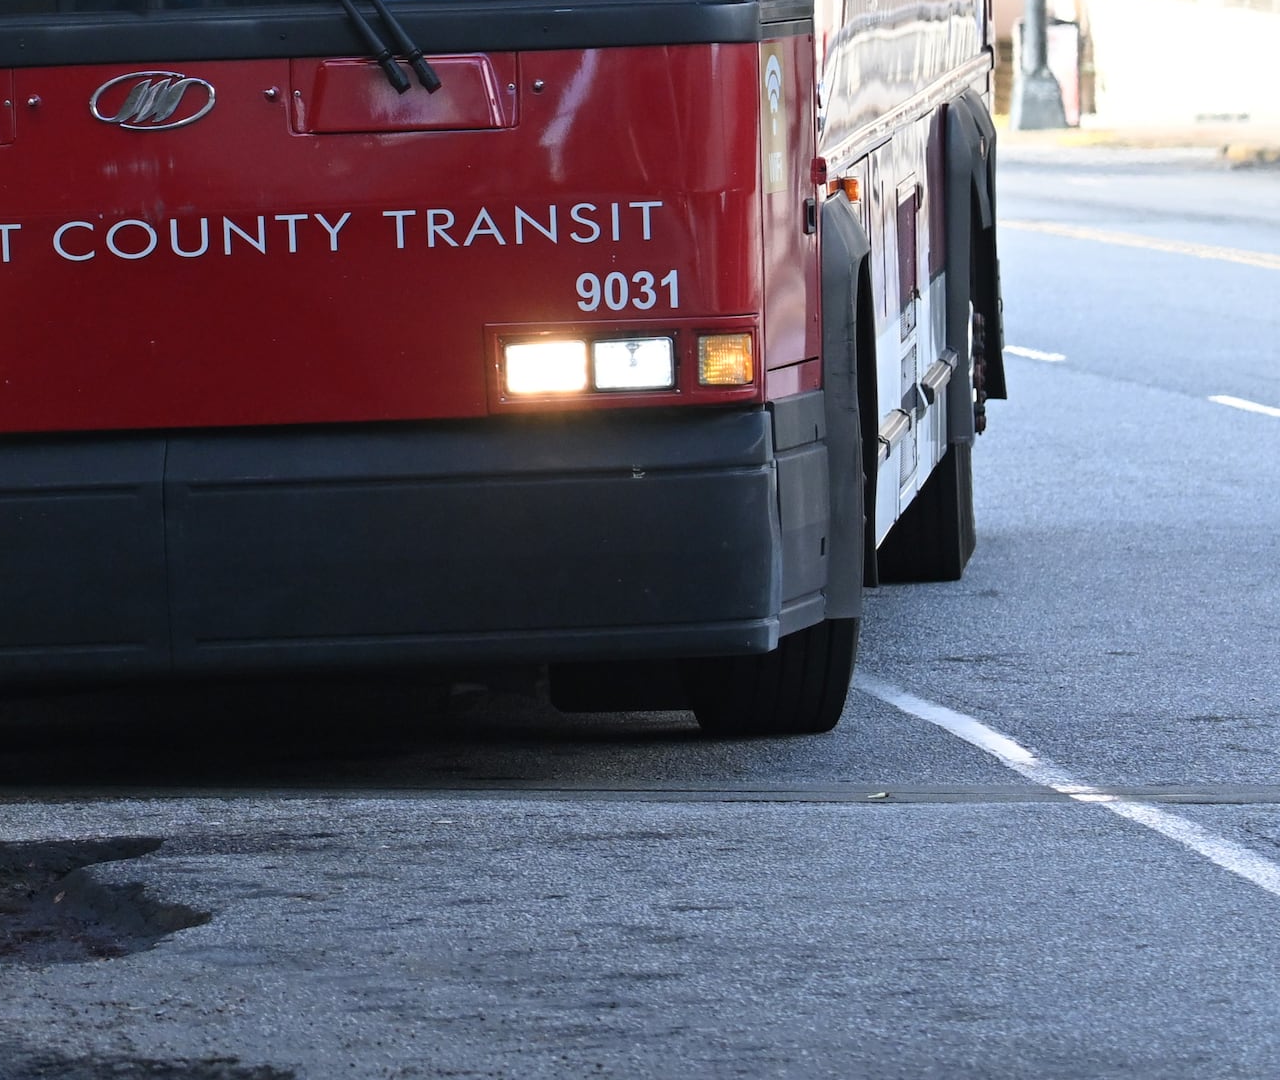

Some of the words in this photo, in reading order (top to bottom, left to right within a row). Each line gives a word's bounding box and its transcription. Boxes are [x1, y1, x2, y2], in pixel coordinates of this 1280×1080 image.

[53, 211, 351, 262] COUNTY
[382, 201, 663, 249] TRANSIT
[575, 268, 680, 311] 9031
